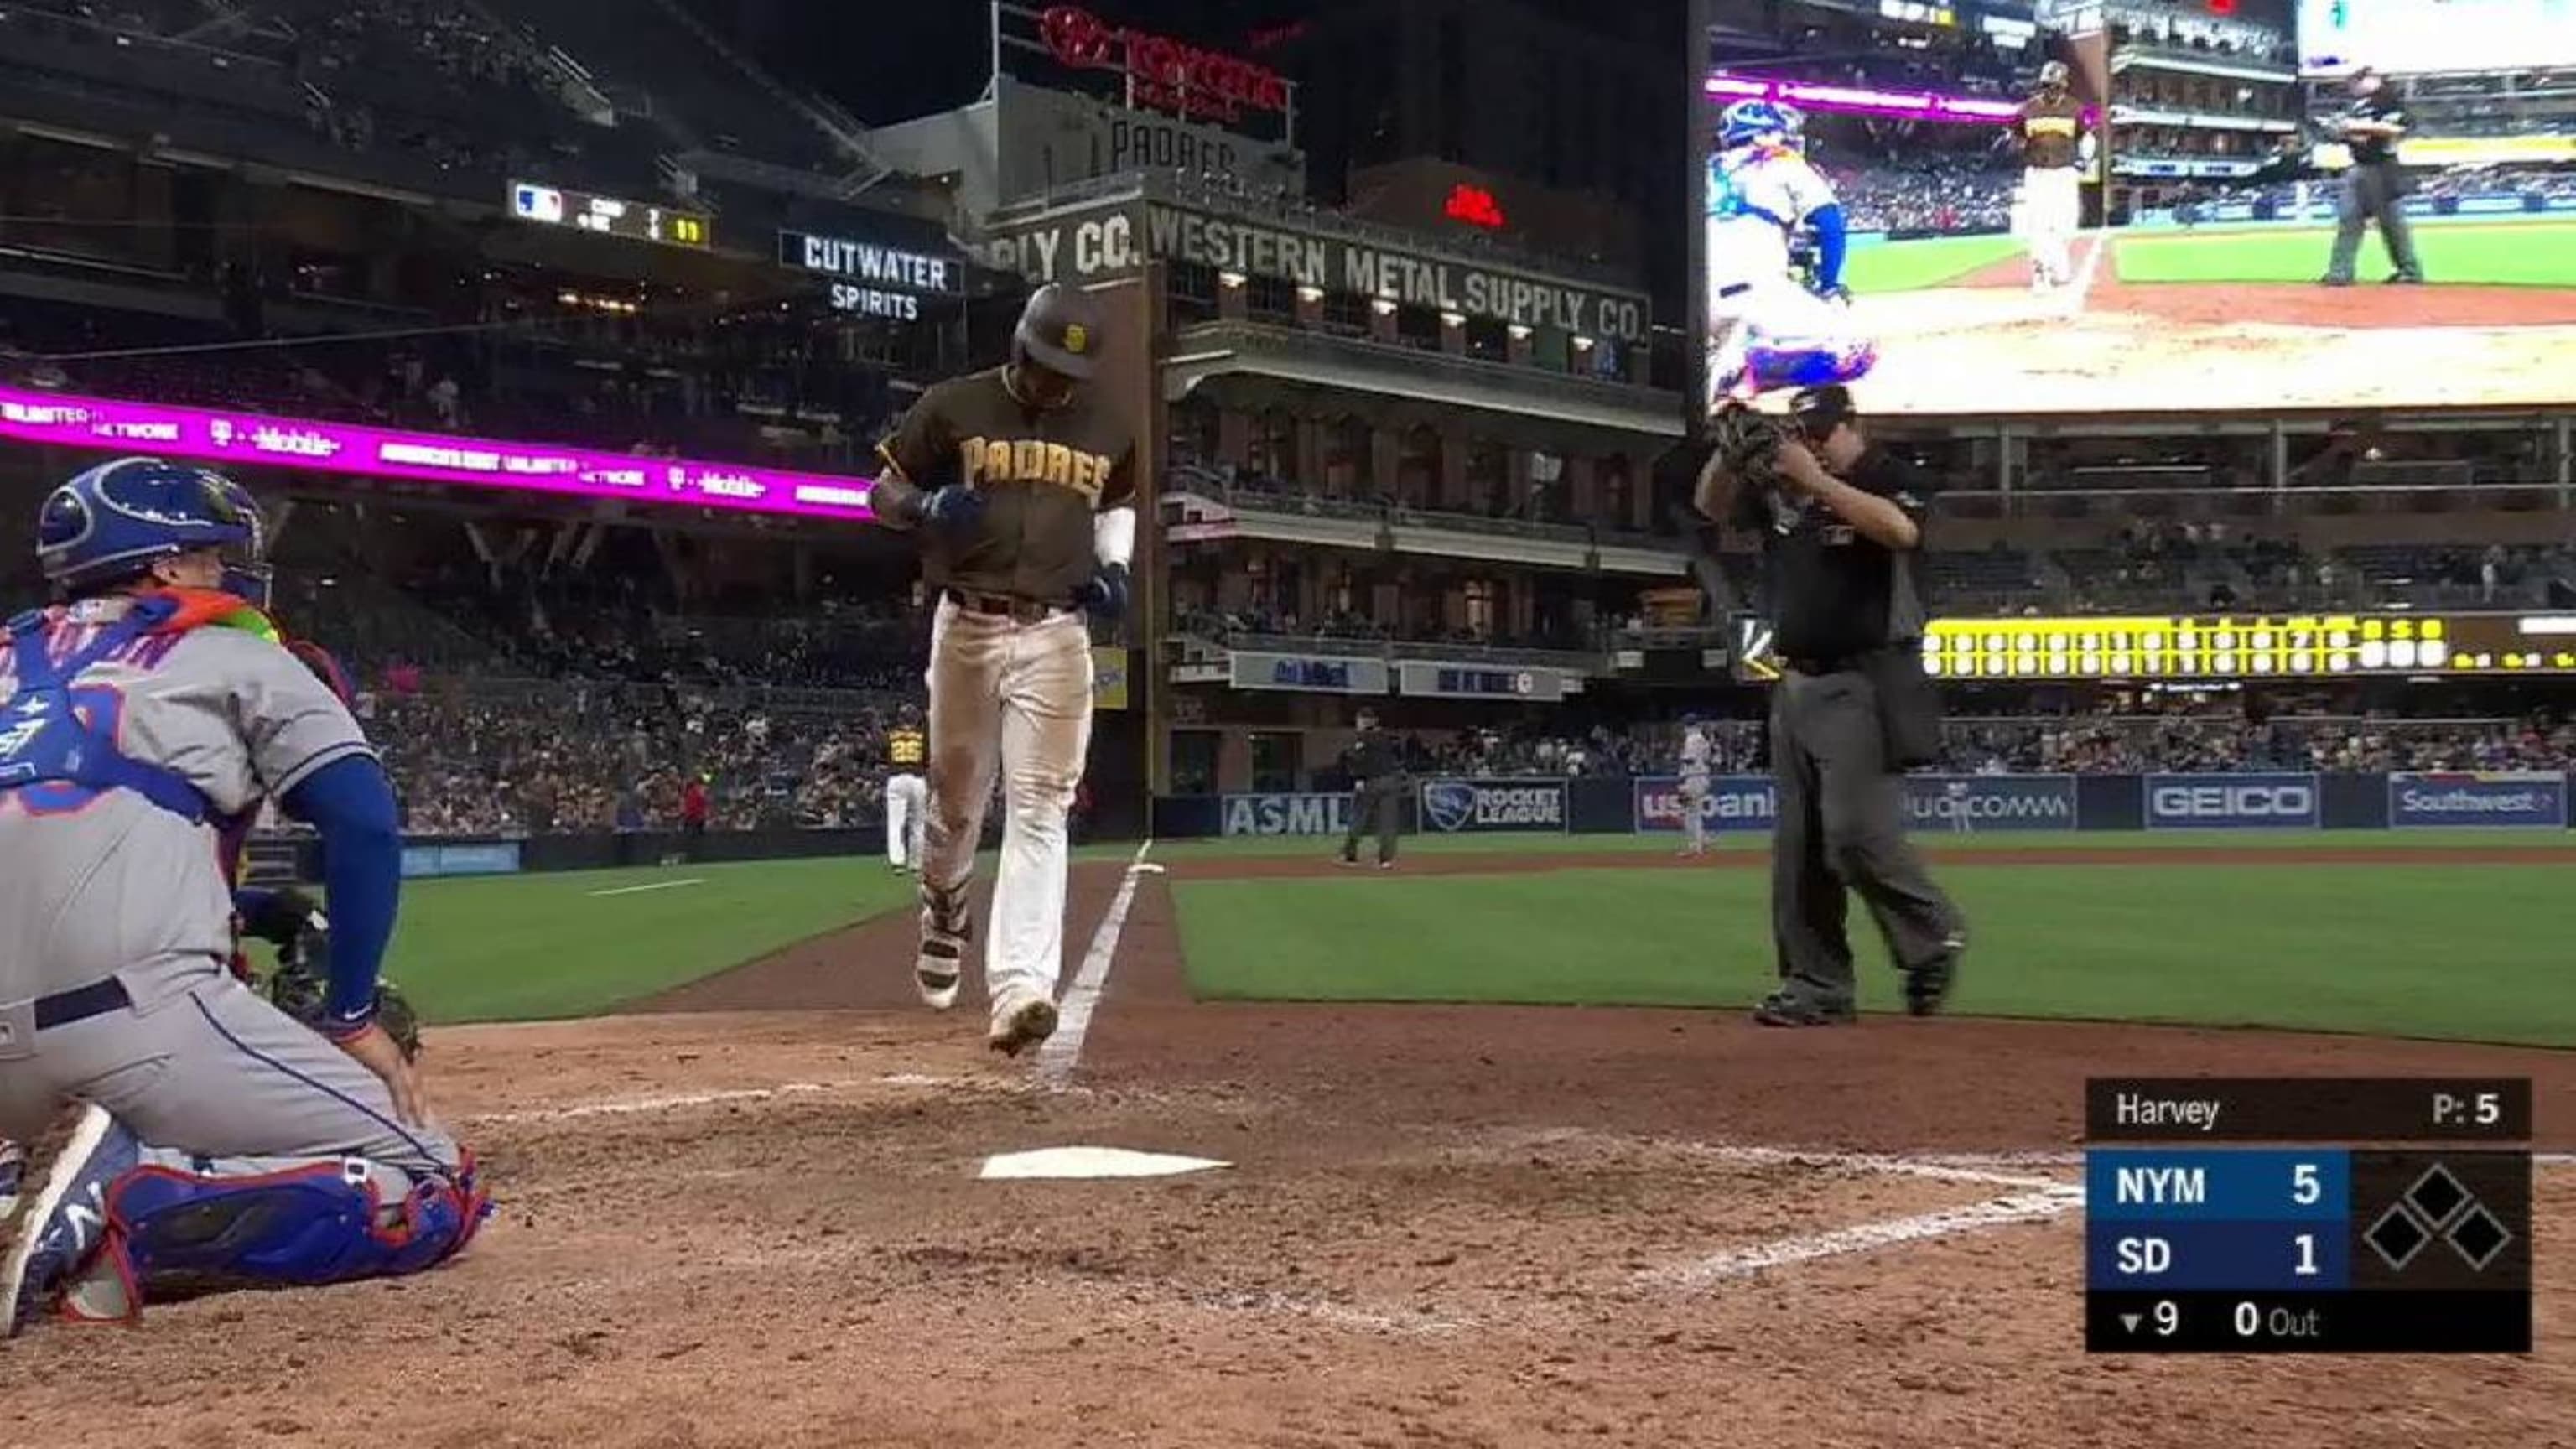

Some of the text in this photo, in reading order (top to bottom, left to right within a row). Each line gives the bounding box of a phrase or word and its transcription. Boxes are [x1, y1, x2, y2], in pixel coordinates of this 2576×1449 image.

[1075, 211, 1142, 274] CO.
[804, 235, 948, 292] CUTWATER
[1151, 206, 1647, 342] WESTERN METAL SUPPLY CO.
[831, 283, 917, 321] SPIRITS
[1228, 797, 1350, 835] ASML
[1475, 788, 1561, 807] ROCKET
[1475, 804, 1561, 823] LEAGUE
[2153, 787, 2311, 817] GEICO
[2402, 791, 2536, 813] Southwest
